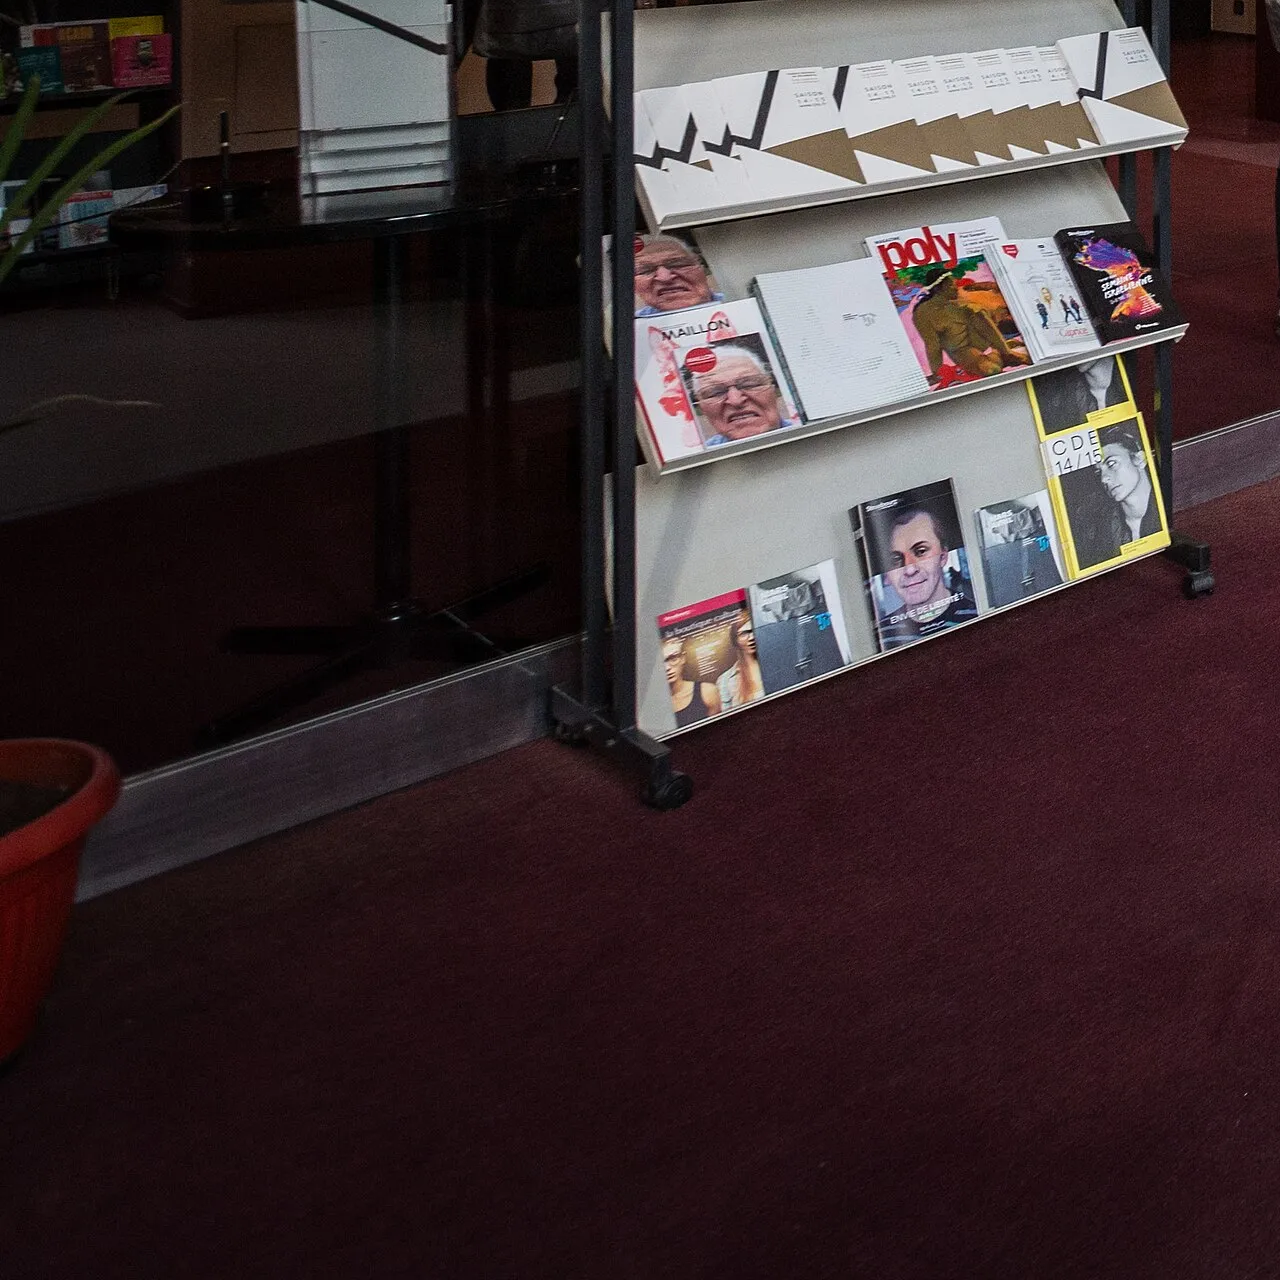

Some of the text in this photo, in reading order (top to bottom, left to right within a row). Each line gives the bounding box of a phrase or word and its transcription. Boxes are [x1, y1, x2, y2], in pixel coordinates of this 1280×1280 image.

[877, 226, 958, 279] poly
[661, 319, 731, 341] MAILLON
[890, 610, 917, 625] ENVIE
